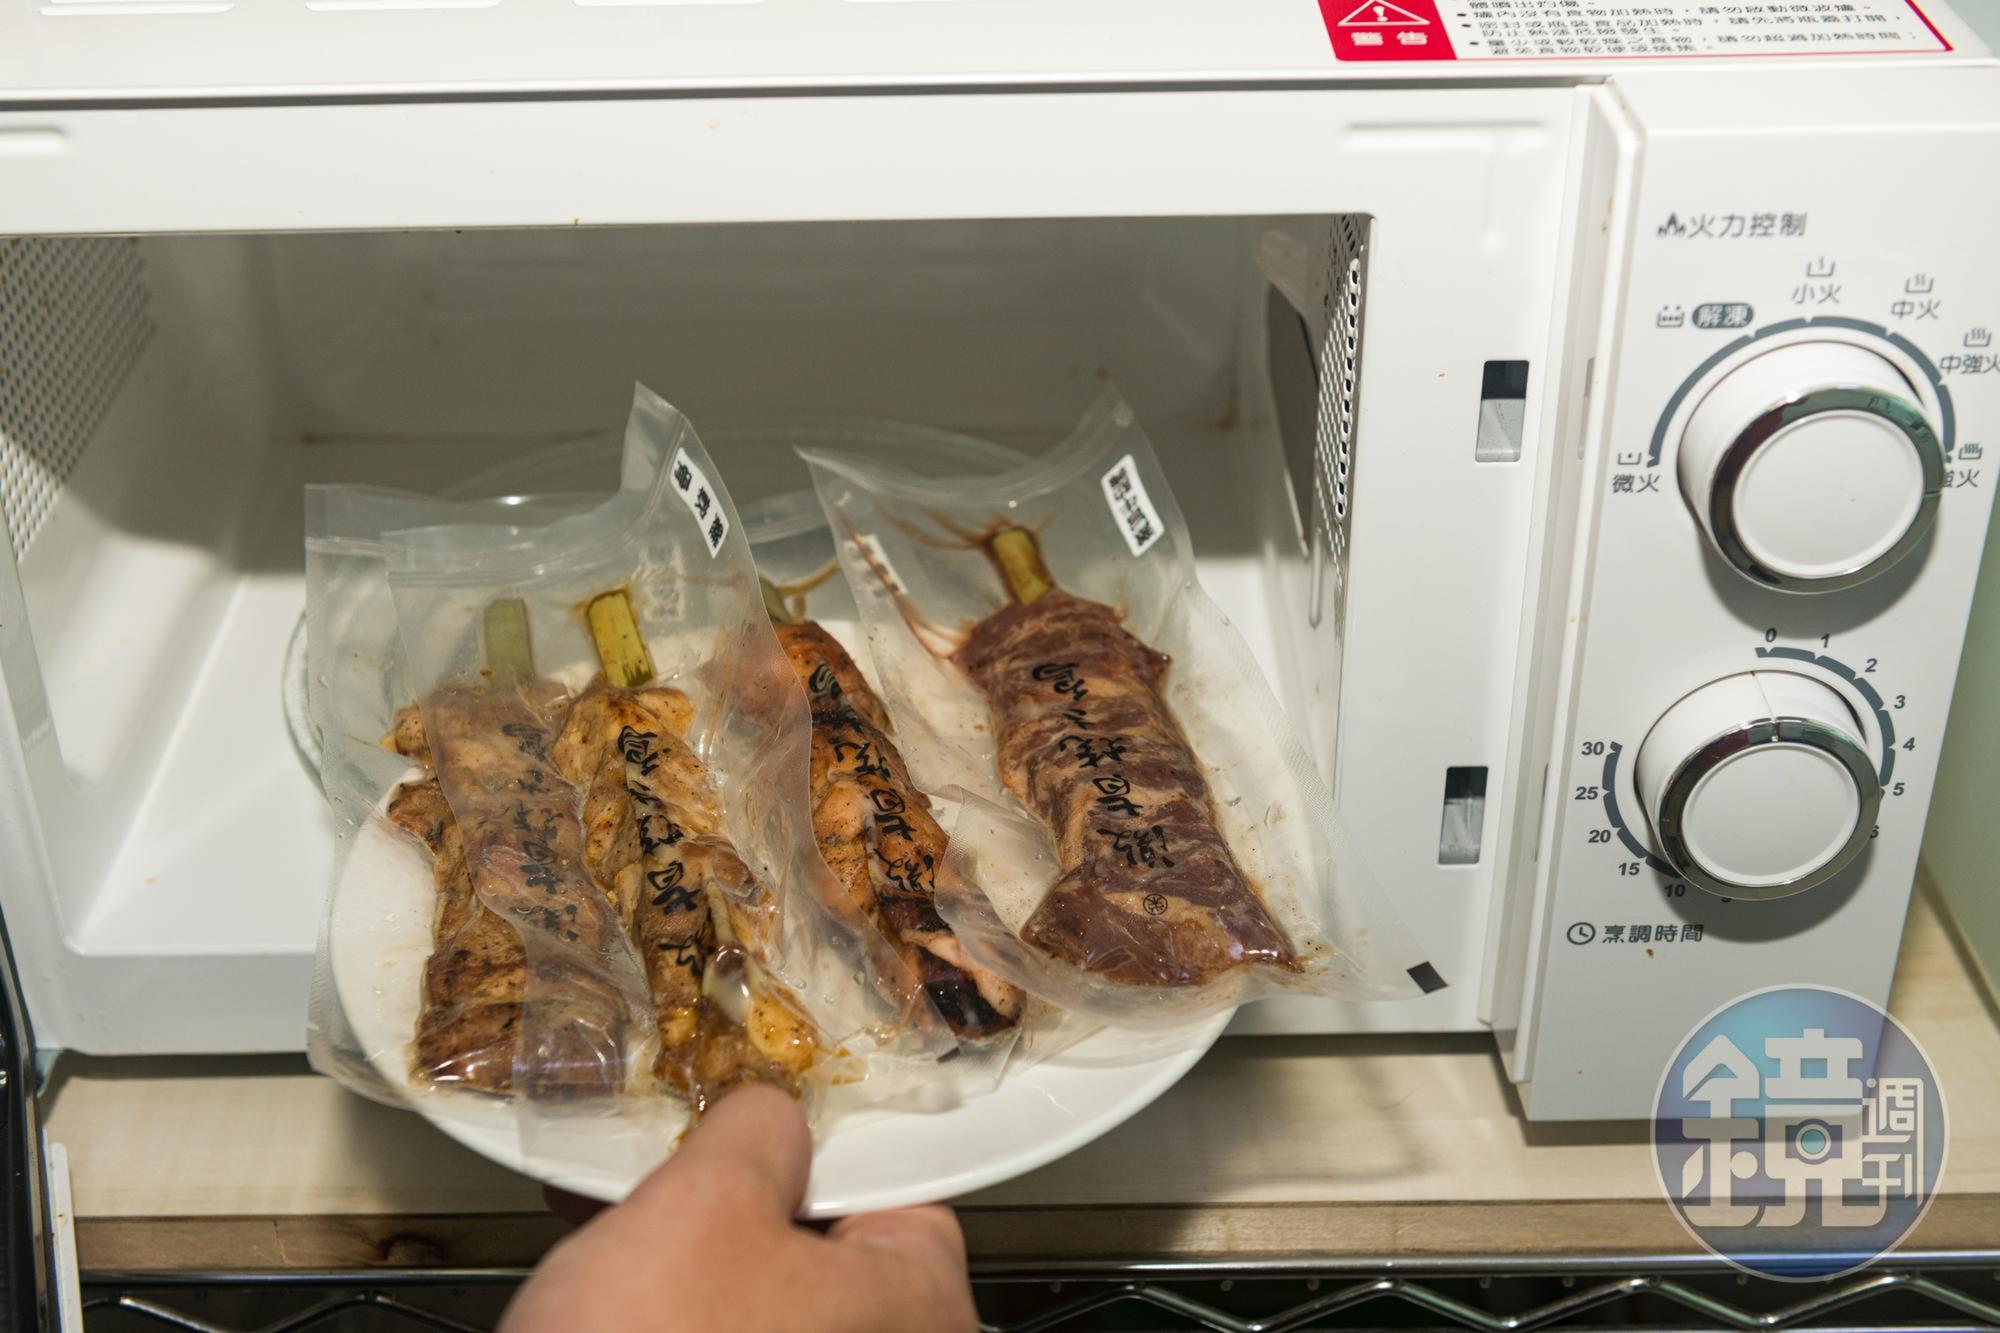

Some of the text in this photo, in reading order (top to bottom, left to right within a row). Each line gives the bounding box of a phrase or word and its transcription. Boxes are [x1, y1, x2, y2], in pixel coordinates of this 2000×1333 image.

[1351, 31, 1428, 46] 警告
[1687, 211, 1808, 238] 火力控制
[1792, 283, 1842, 304] 小火
[1696, 304, 1749, 326] 解凍
[1891, 300, 1941, 320] 中火
[1940, 354, 2000, 374] 中強火
[1611, 474, 1661, 494] 微火
[1764, 628, 1777, 643] 0
[1820, 634, 1830, 648] 1
[1864, 658, 1877, 673] 2
[1894, 695, 1906, 709] 3
[1581, 741, 1605, 755] 30
[1903, 737, 1916, 751] 4
[1574, 787, 1599, 800] 25
[1893, 782, 1905, 796] 5
[1588, 830, 1611, 843] 20
[1617, 863, 1640, 876] 15
[1664, 884, 1686, 897] 10
[1602, 924, 1705, 943] 烹調時間
